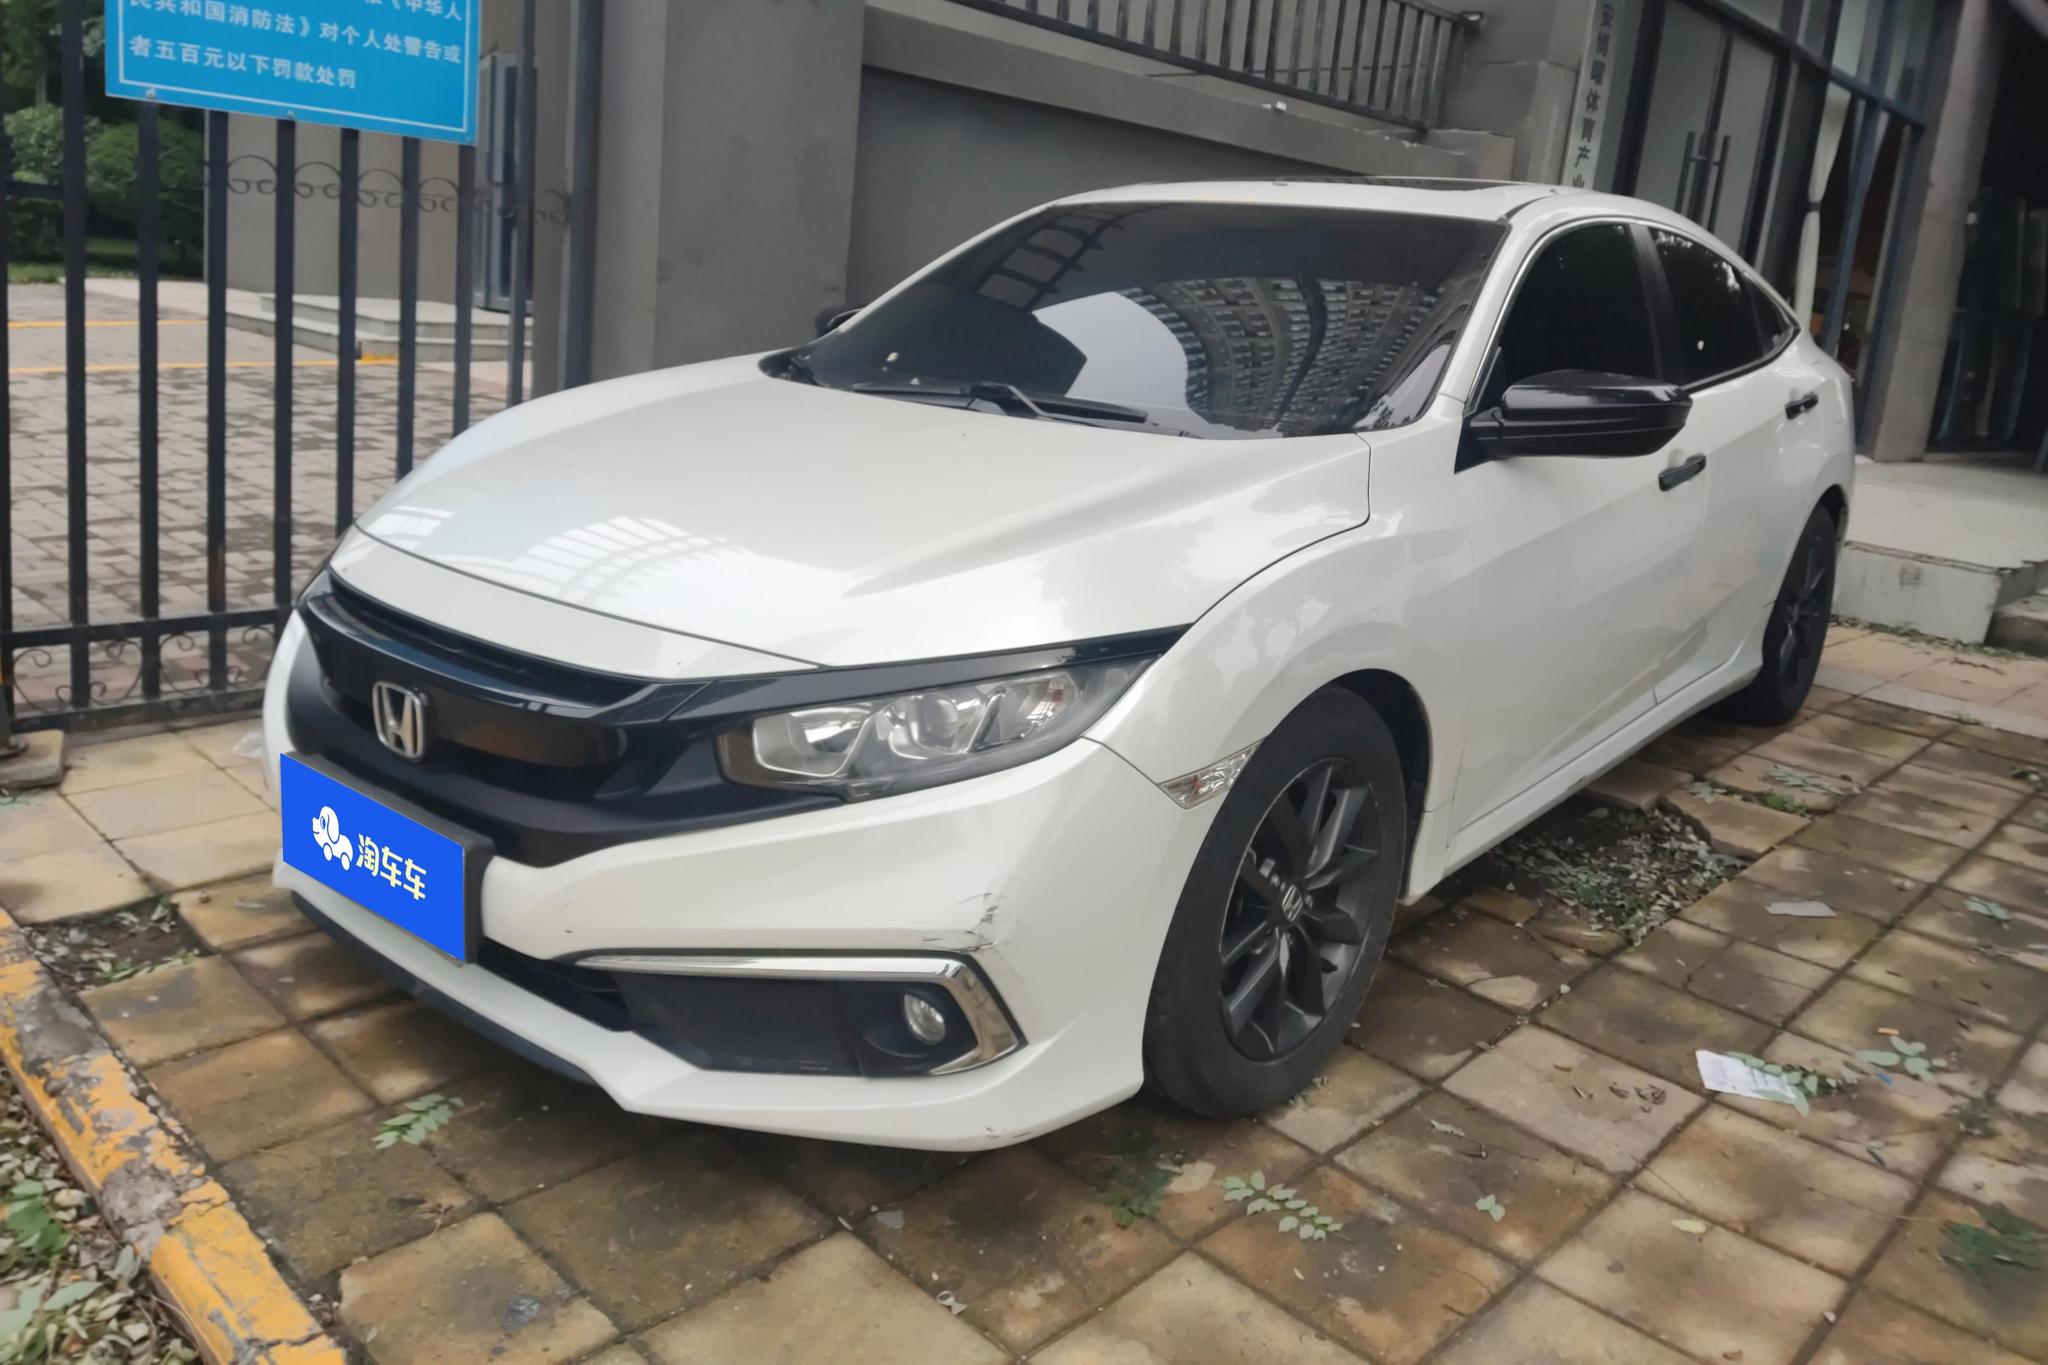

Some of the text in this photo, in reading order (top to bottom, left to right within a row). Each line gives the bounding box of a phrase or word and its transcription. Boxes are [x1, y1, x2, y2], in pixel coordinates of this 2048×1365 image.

[365, 0, 462, 21] 《中华人
[129, 35, 357, 89] 者五百元以下罚款处罚
